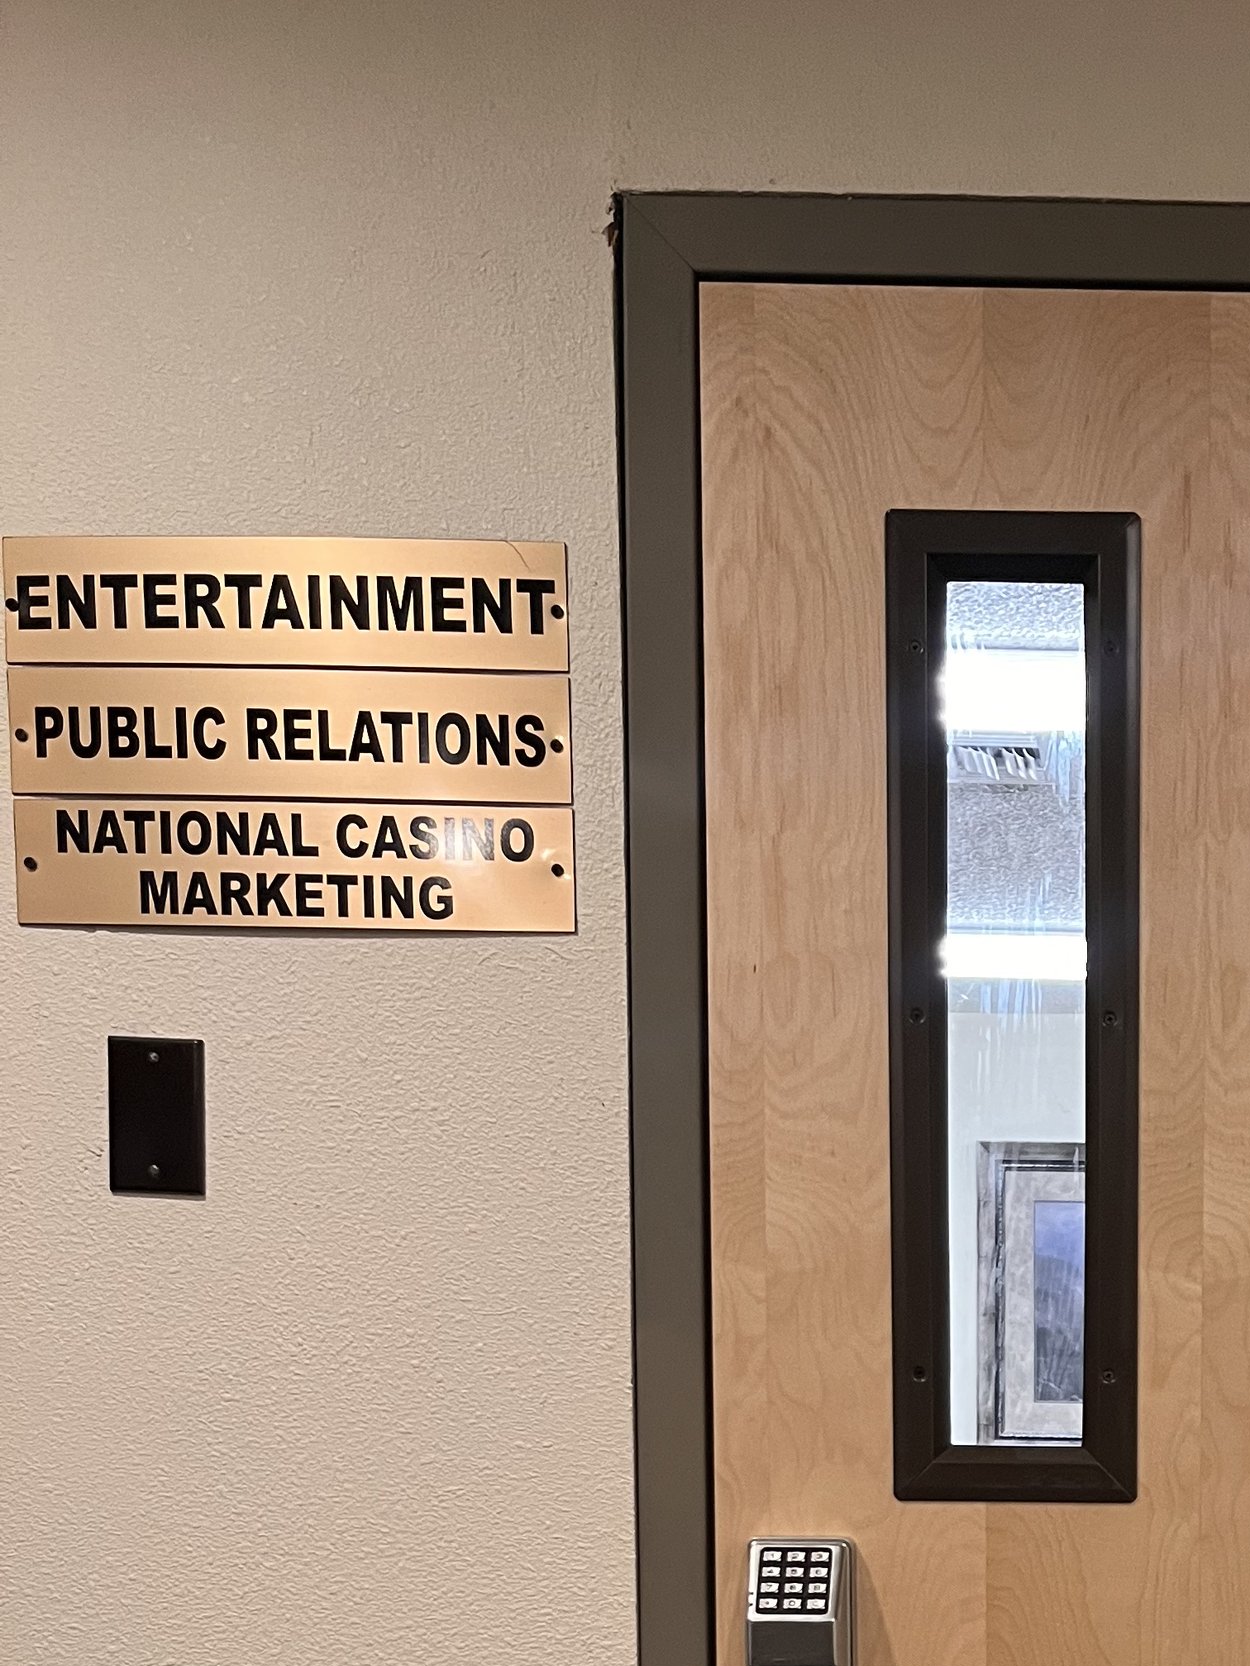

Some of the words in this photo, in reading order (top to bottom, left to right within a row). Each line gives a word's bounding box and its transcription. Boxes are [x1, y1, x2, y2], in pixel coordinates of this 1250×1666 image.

[16, 574, 555, 635] ENTERTAINMENT
[35, 706, 227, 760] PUBLIC
[247, 708, 547, 768] RELATIONS
[56, 810, 319, 857] NATIONAL
[336, 814, 535, 863] CASINO
[139, 871, 454, 920] MARKETING
